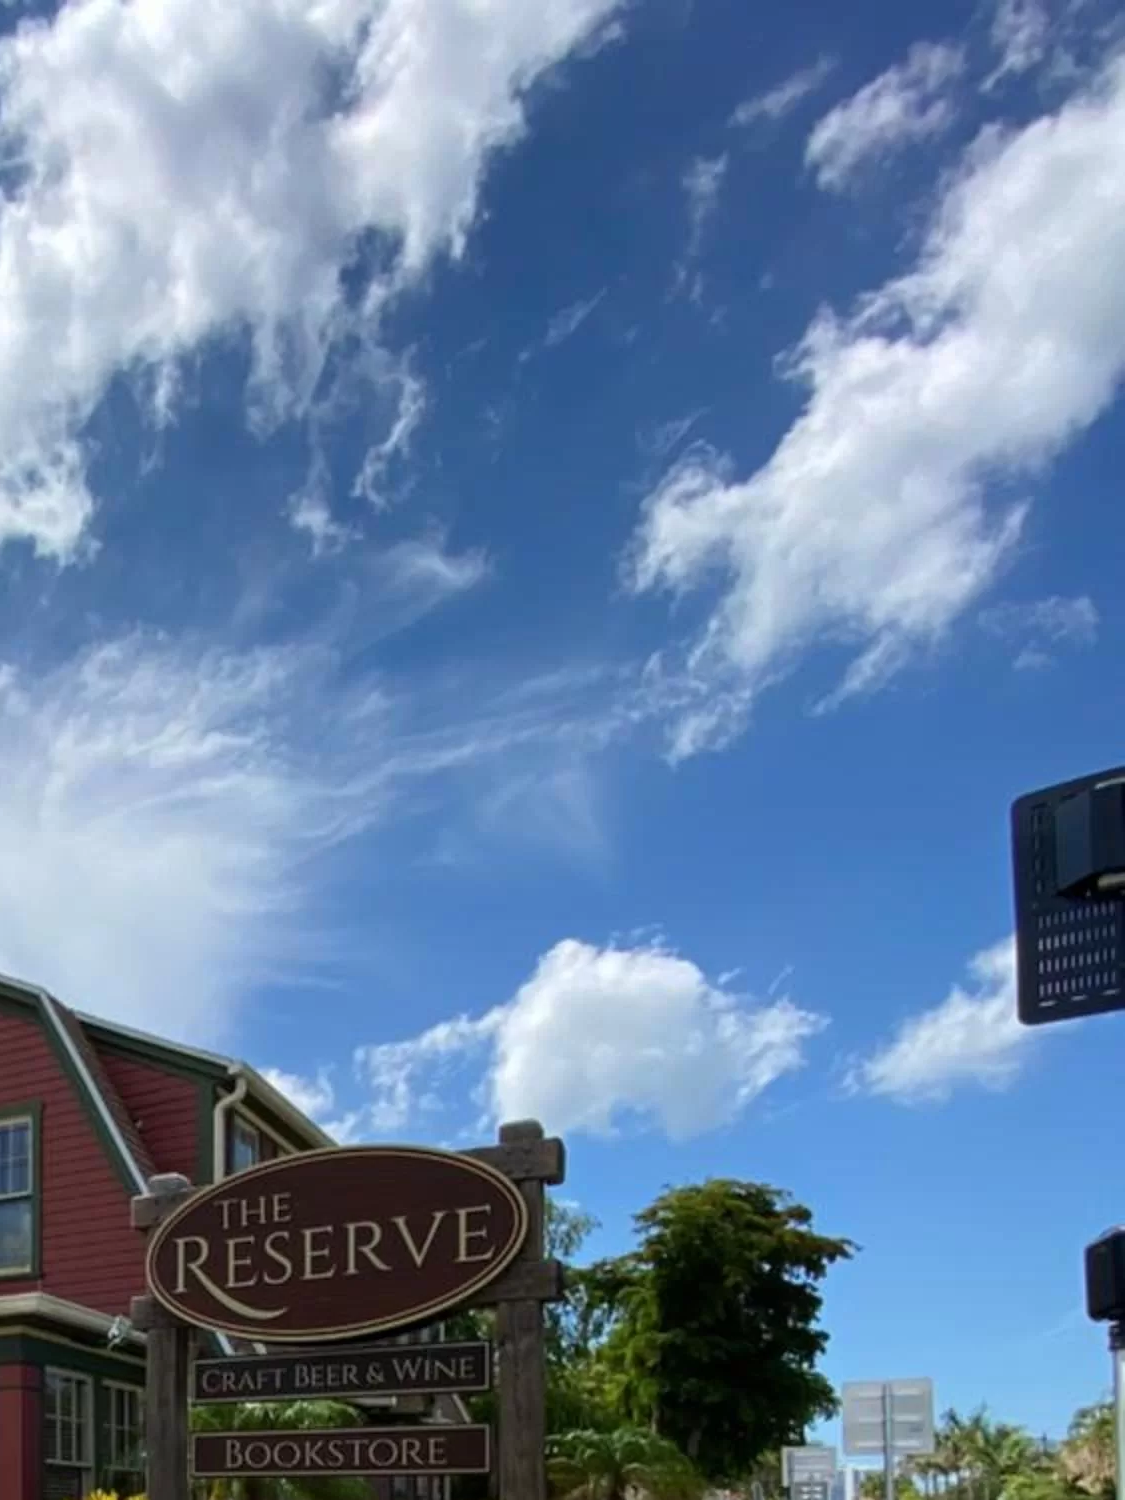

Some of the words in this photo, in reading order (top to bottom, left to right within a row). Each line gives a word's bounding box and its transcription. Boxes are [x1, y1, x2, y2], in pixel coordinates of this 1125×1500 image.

[214, 1192, 292, 1230] THE
[172, 1204, 496, 1321] RESERVE
[201, 1369, 284, 1394] CRAFT
[294, 1362, 359, 1387] BEER
[365, 1360, 385, 1383] &
[392, 1355, 476, 1380] WINE
[225, 1437, 447, 1470] BOOKSTORE
